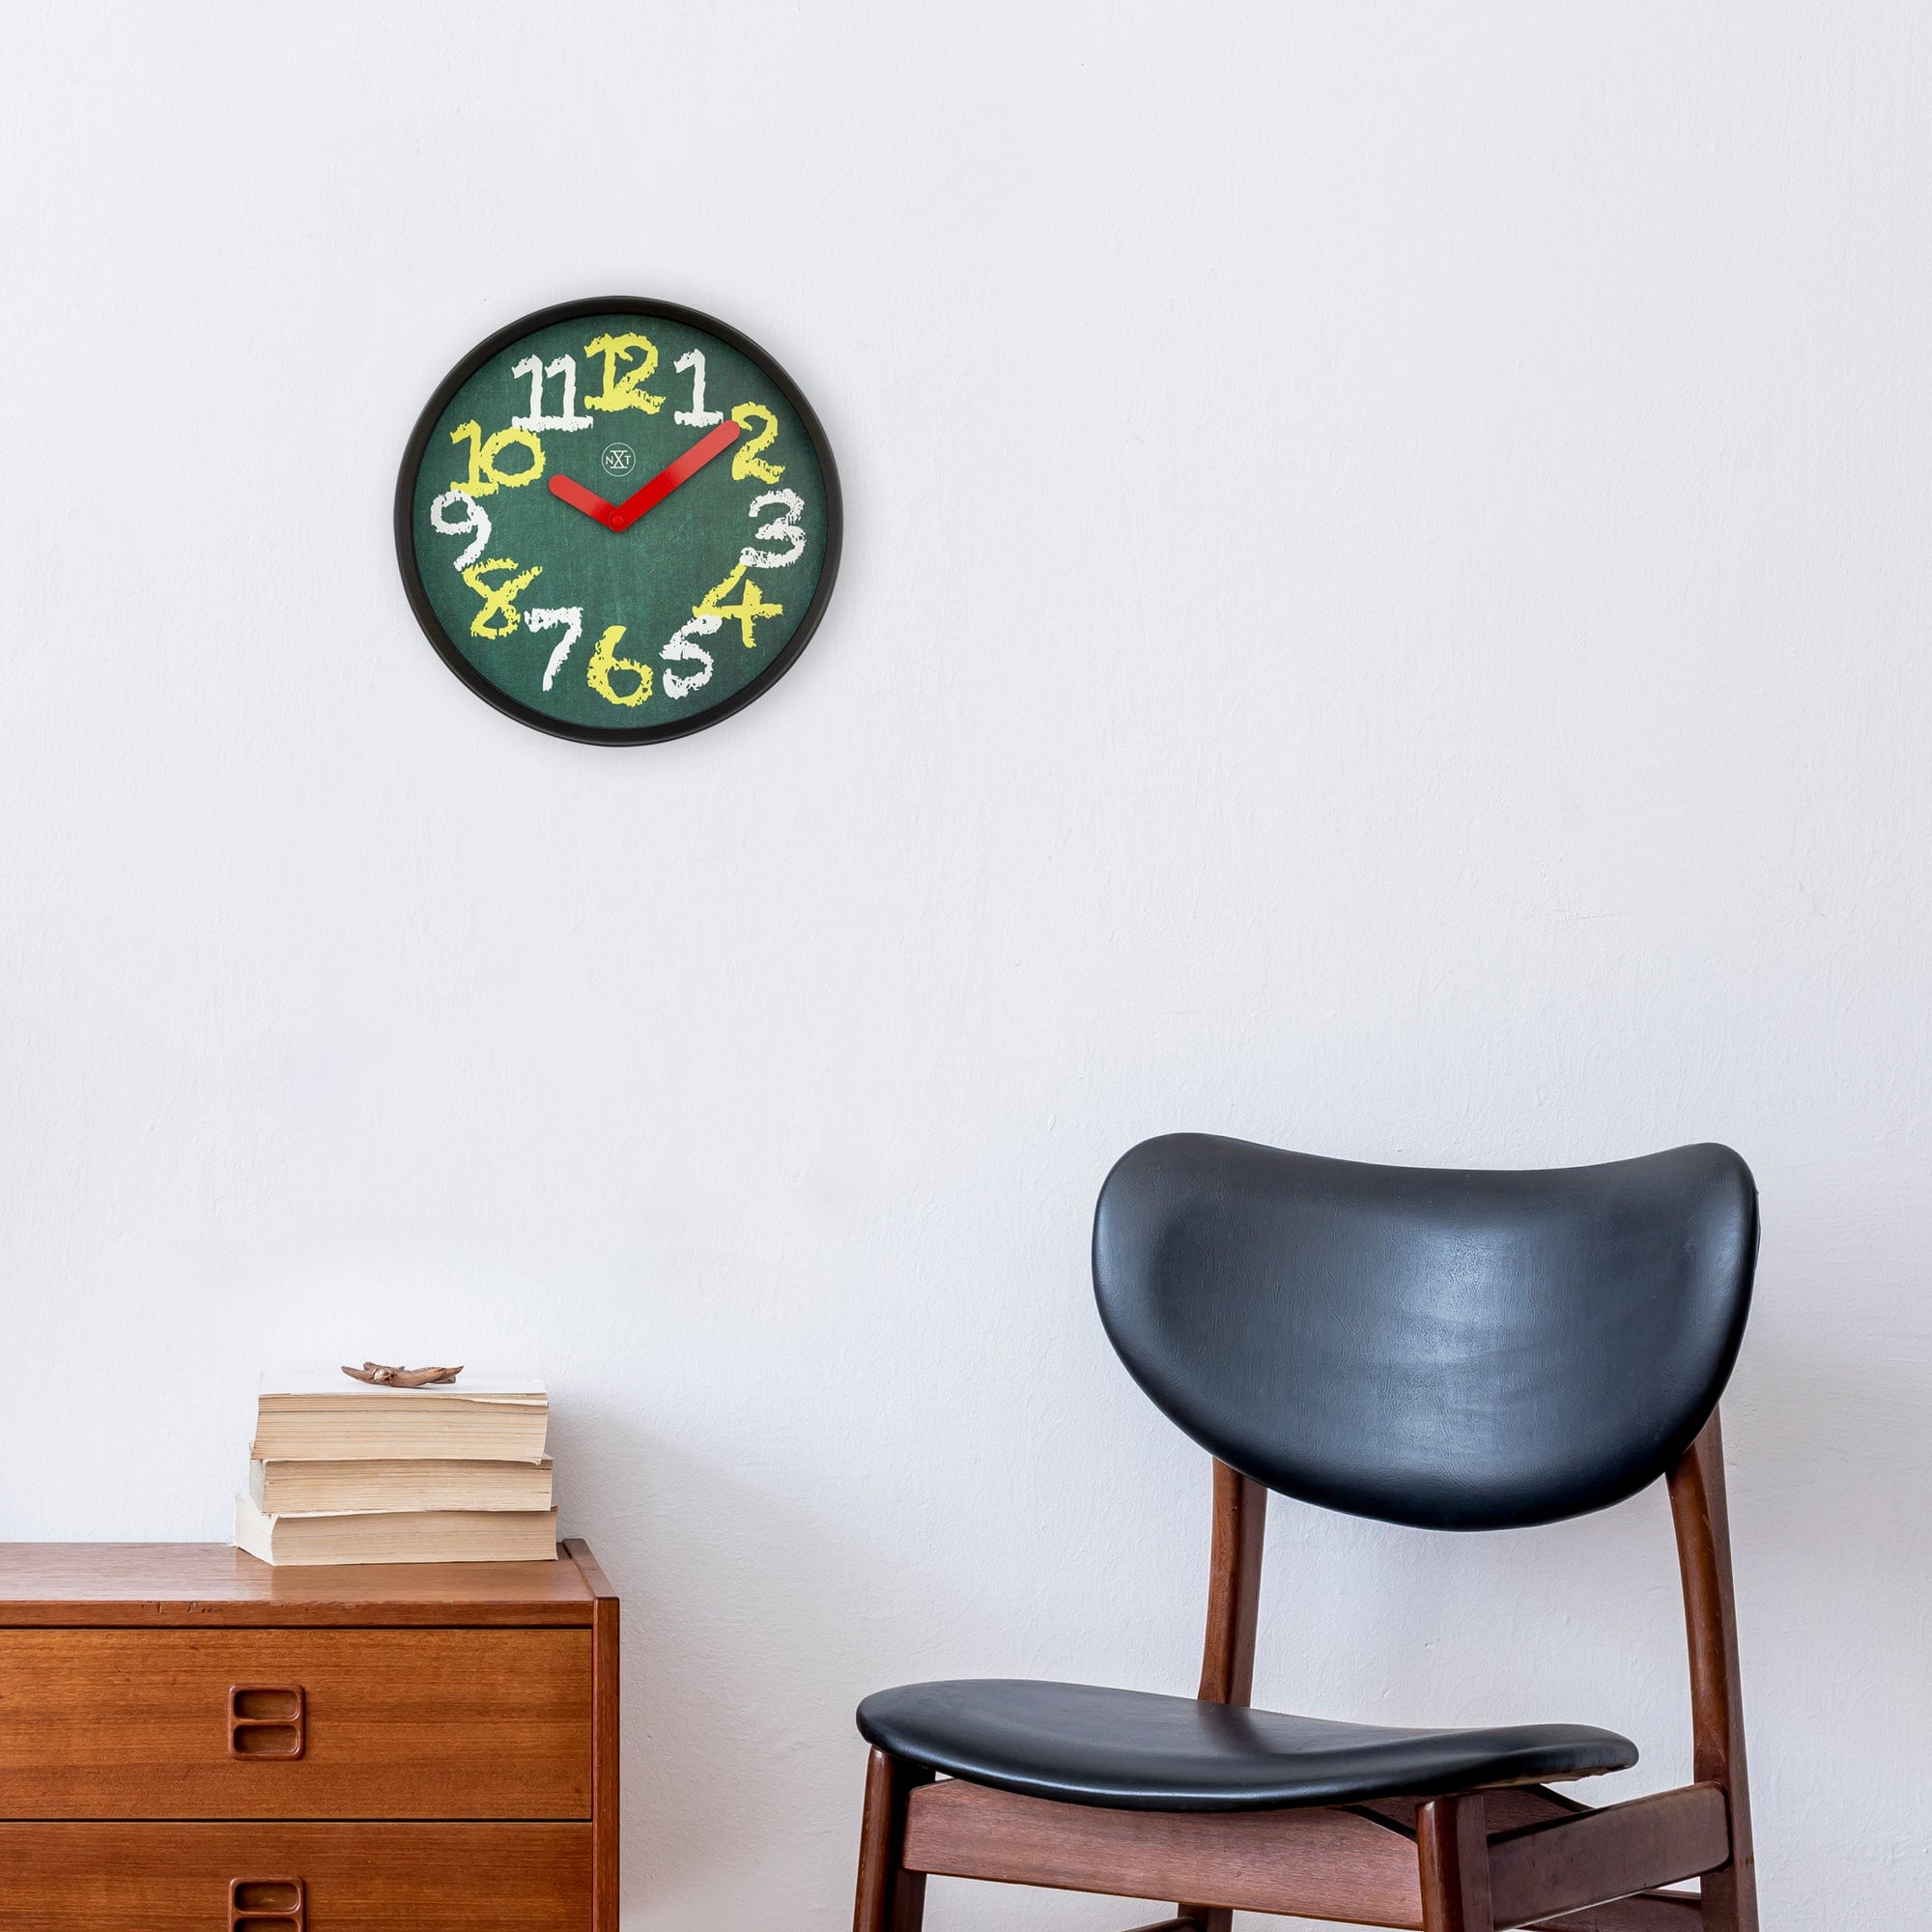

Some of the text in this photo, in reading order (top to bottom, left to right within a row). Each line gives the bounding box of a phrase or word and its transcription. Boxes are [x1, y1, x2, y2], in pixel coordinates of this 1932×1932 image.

[511, 355, 593, 431] 11
[584, 332, 666, 413] 12
[673, 349, 724, 427] 1
[450, 419, 546, 497] 10
[606, 450, 631, 469] NXT
[731, 401, 785, 484] 2
[431, 490, 492, 571] 9
[740, 488, 806, 568] 3
[463, 557, 543, 639] 8
[692, 563, 783, 648] 4
[524, 607, 583, 692] 7
[587, 625, 653, 707] 6
[659, 614, 723, 699] 5
